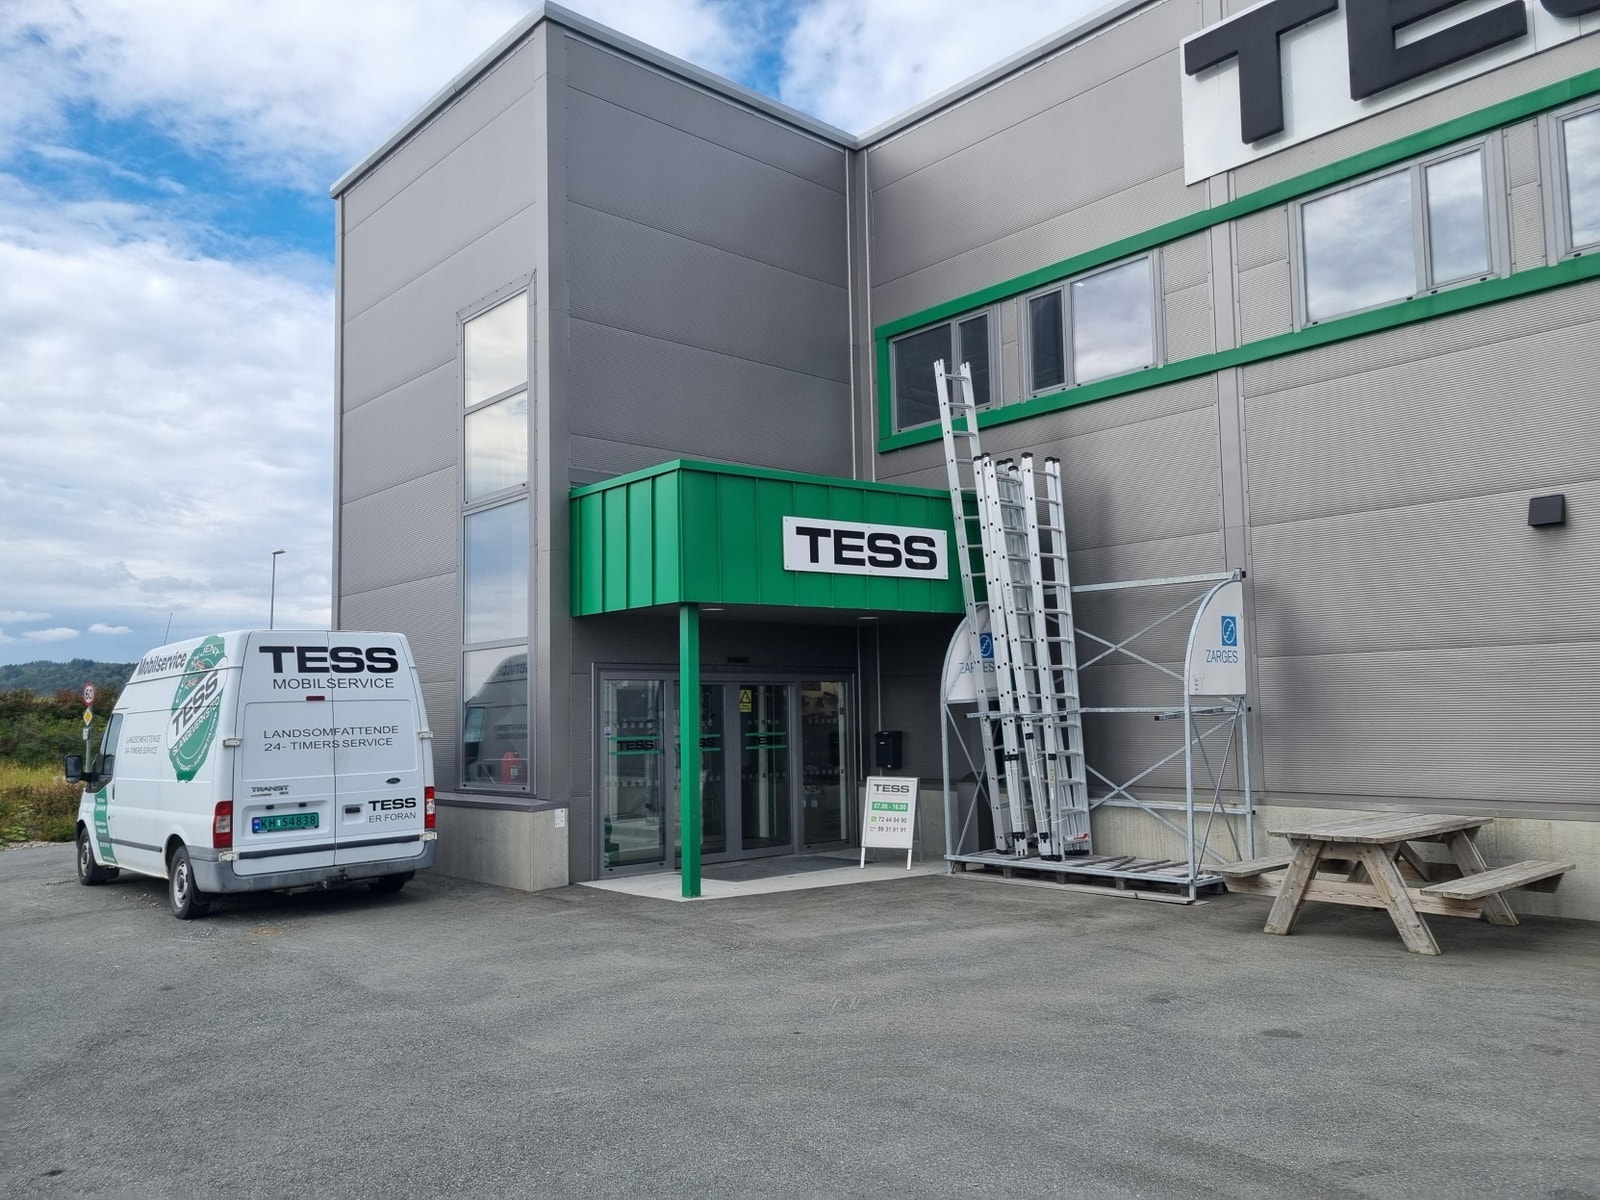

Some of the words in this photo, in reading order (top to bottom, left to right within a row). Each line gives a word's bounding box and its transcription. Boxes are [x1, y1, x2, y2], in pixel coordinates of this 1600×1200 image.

[1184, 0, 1600, 145] TE
[795, 526, 938, 571] TESS
[259, 645, 399, 674] TESS
[1206, 649, 1239, 663] ZARGES
[137, 651, 187, 676] Mobilservice
[273, 678, 395, 690] MOBILSERVICE
[172, 669, 218, 737] TESS
[263, 725, 399, 739] LANDSOMFATTENDE
[290, 740, 340, 750] TIMERS
[342, 738, 393, 748] SERVICE
[616, 740, 655, 752] TESS
[251, 784, 289, 793] TRANSIT
[873, 784, 910, 793] TESS
[368, 797, 417, 812] TESS
[261, 818, 276, 829] KH
[282, 815, 316, 827] 54838
[368, 814, 382, 824] ER
[384, 811, 417, 822] FORAN
